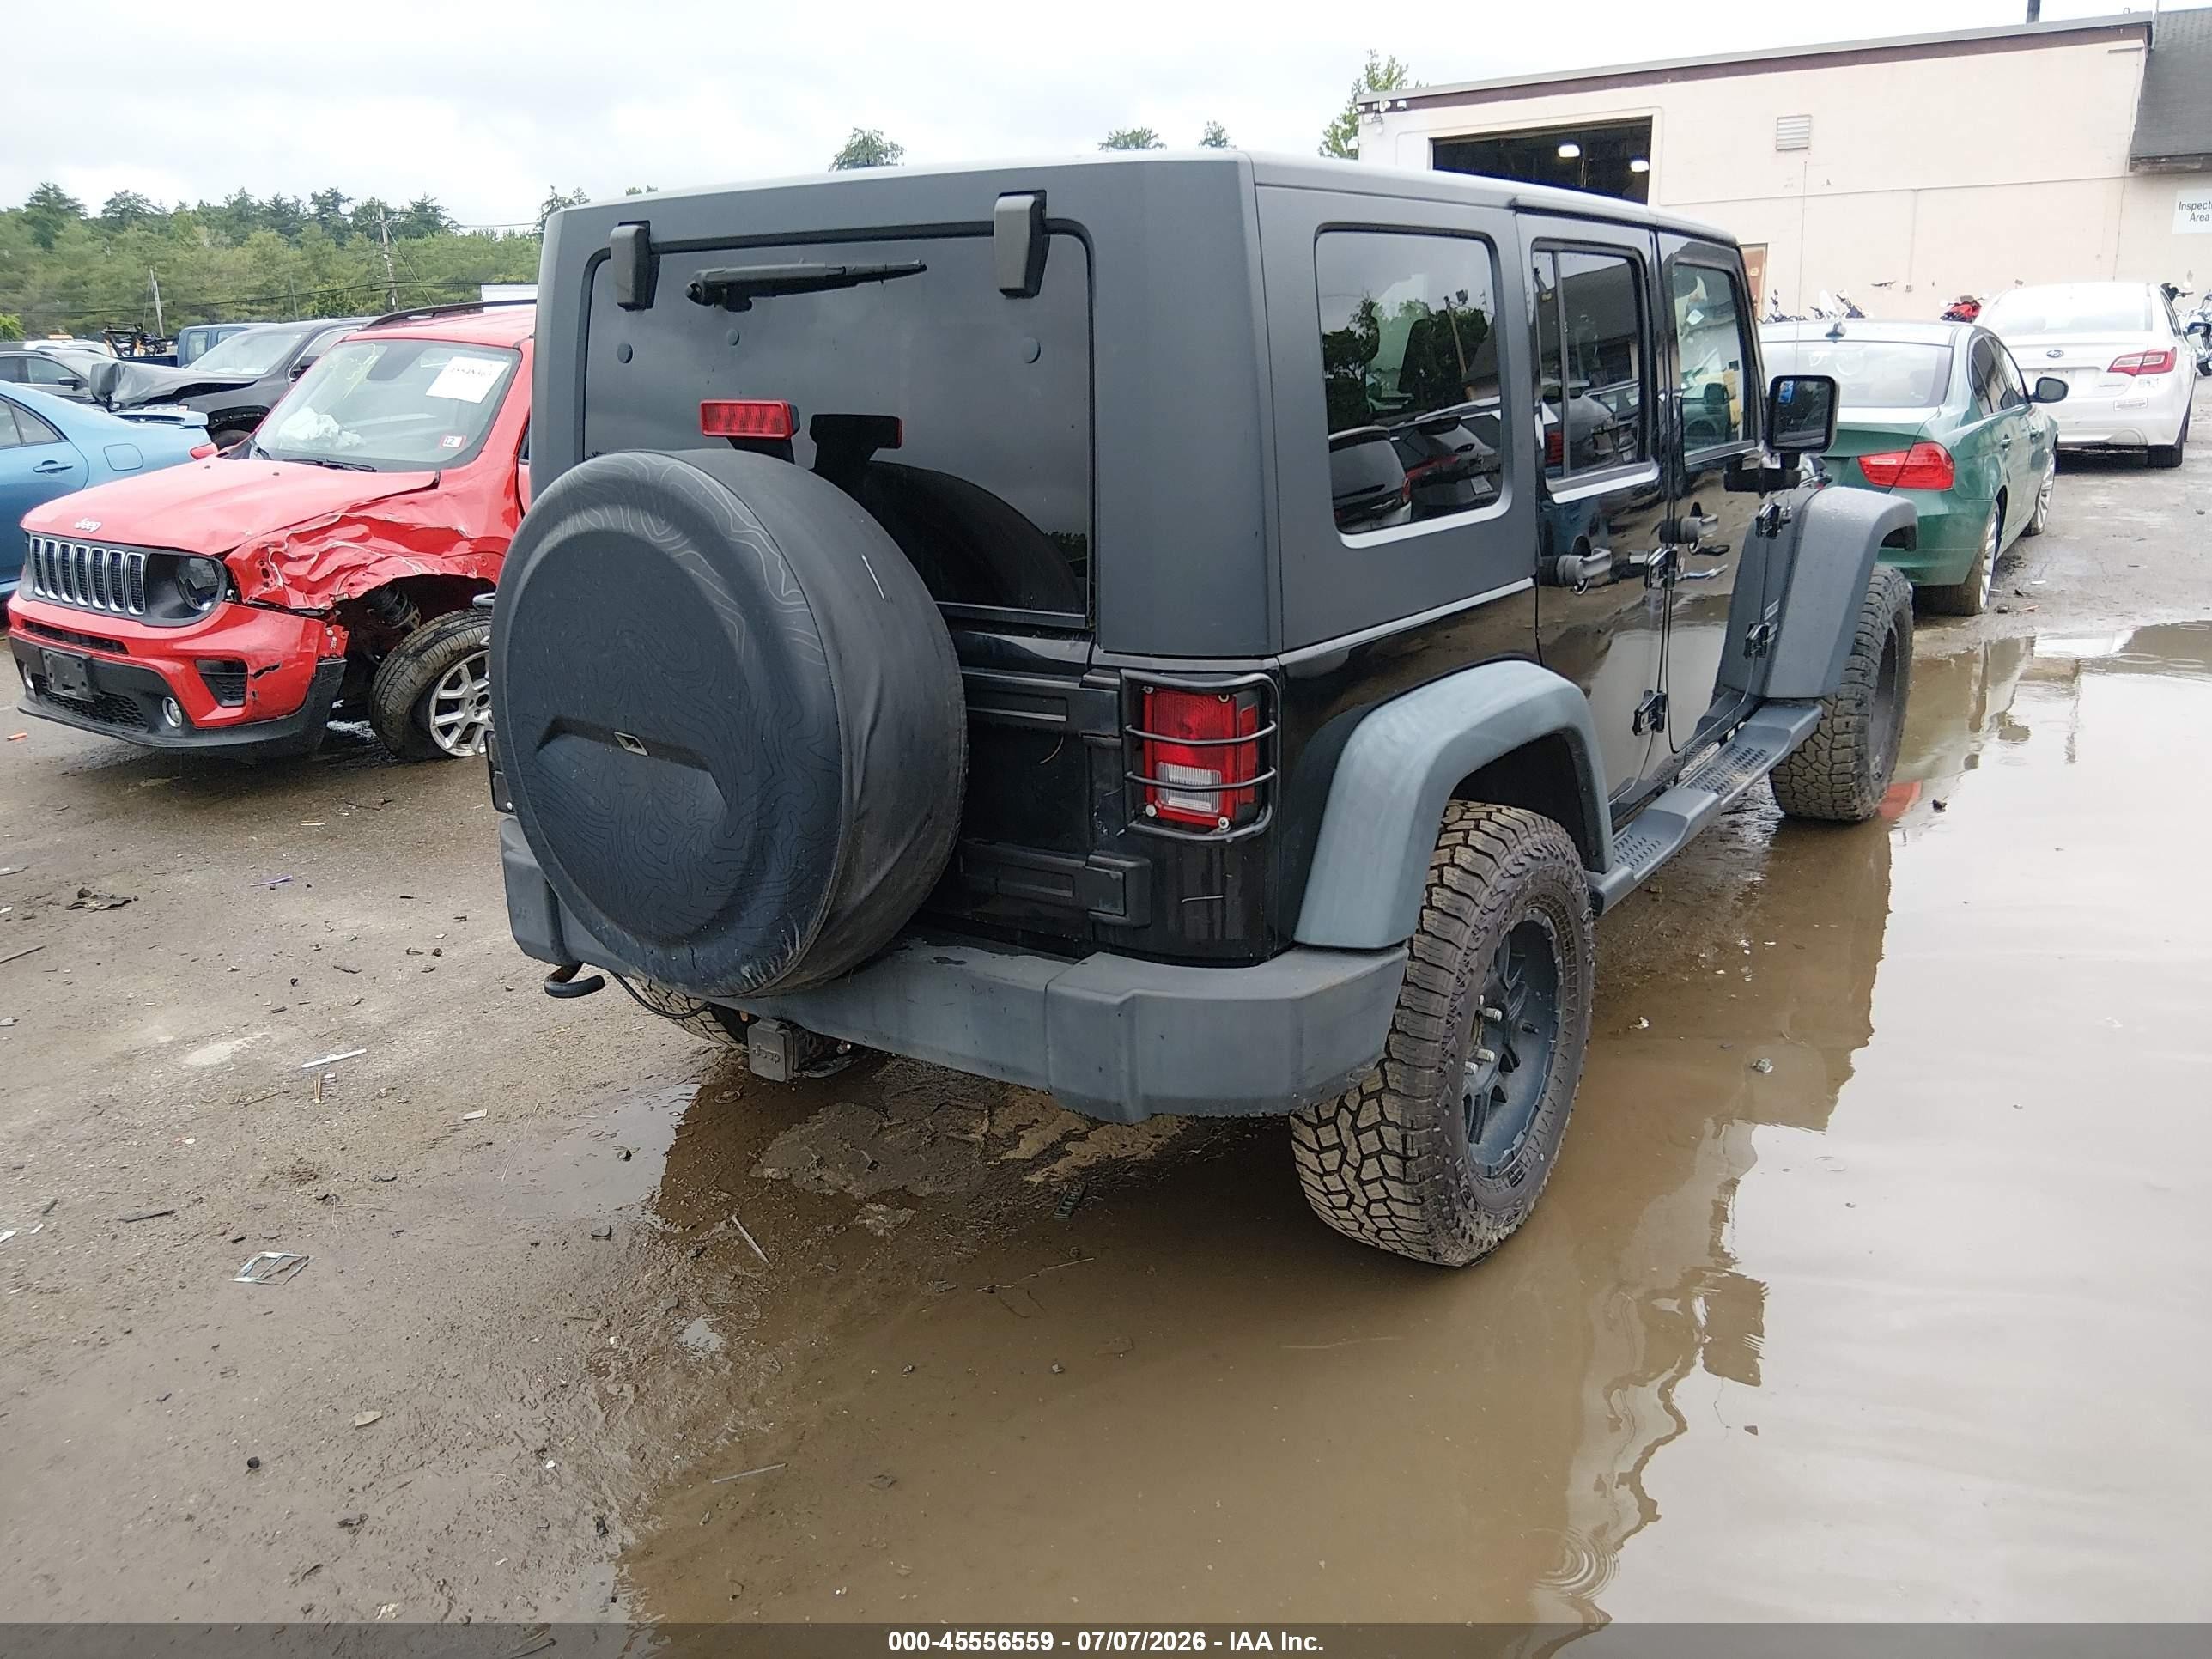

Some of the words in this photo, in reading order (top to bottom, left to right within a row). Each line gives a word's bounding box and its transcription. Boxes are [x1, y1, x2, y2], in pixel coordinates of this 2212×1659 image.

[2190, 212, 2210, 222] Area
[74, 517, 102, 533] Jeep
[752, 1042, 781, 1065] Jeep
